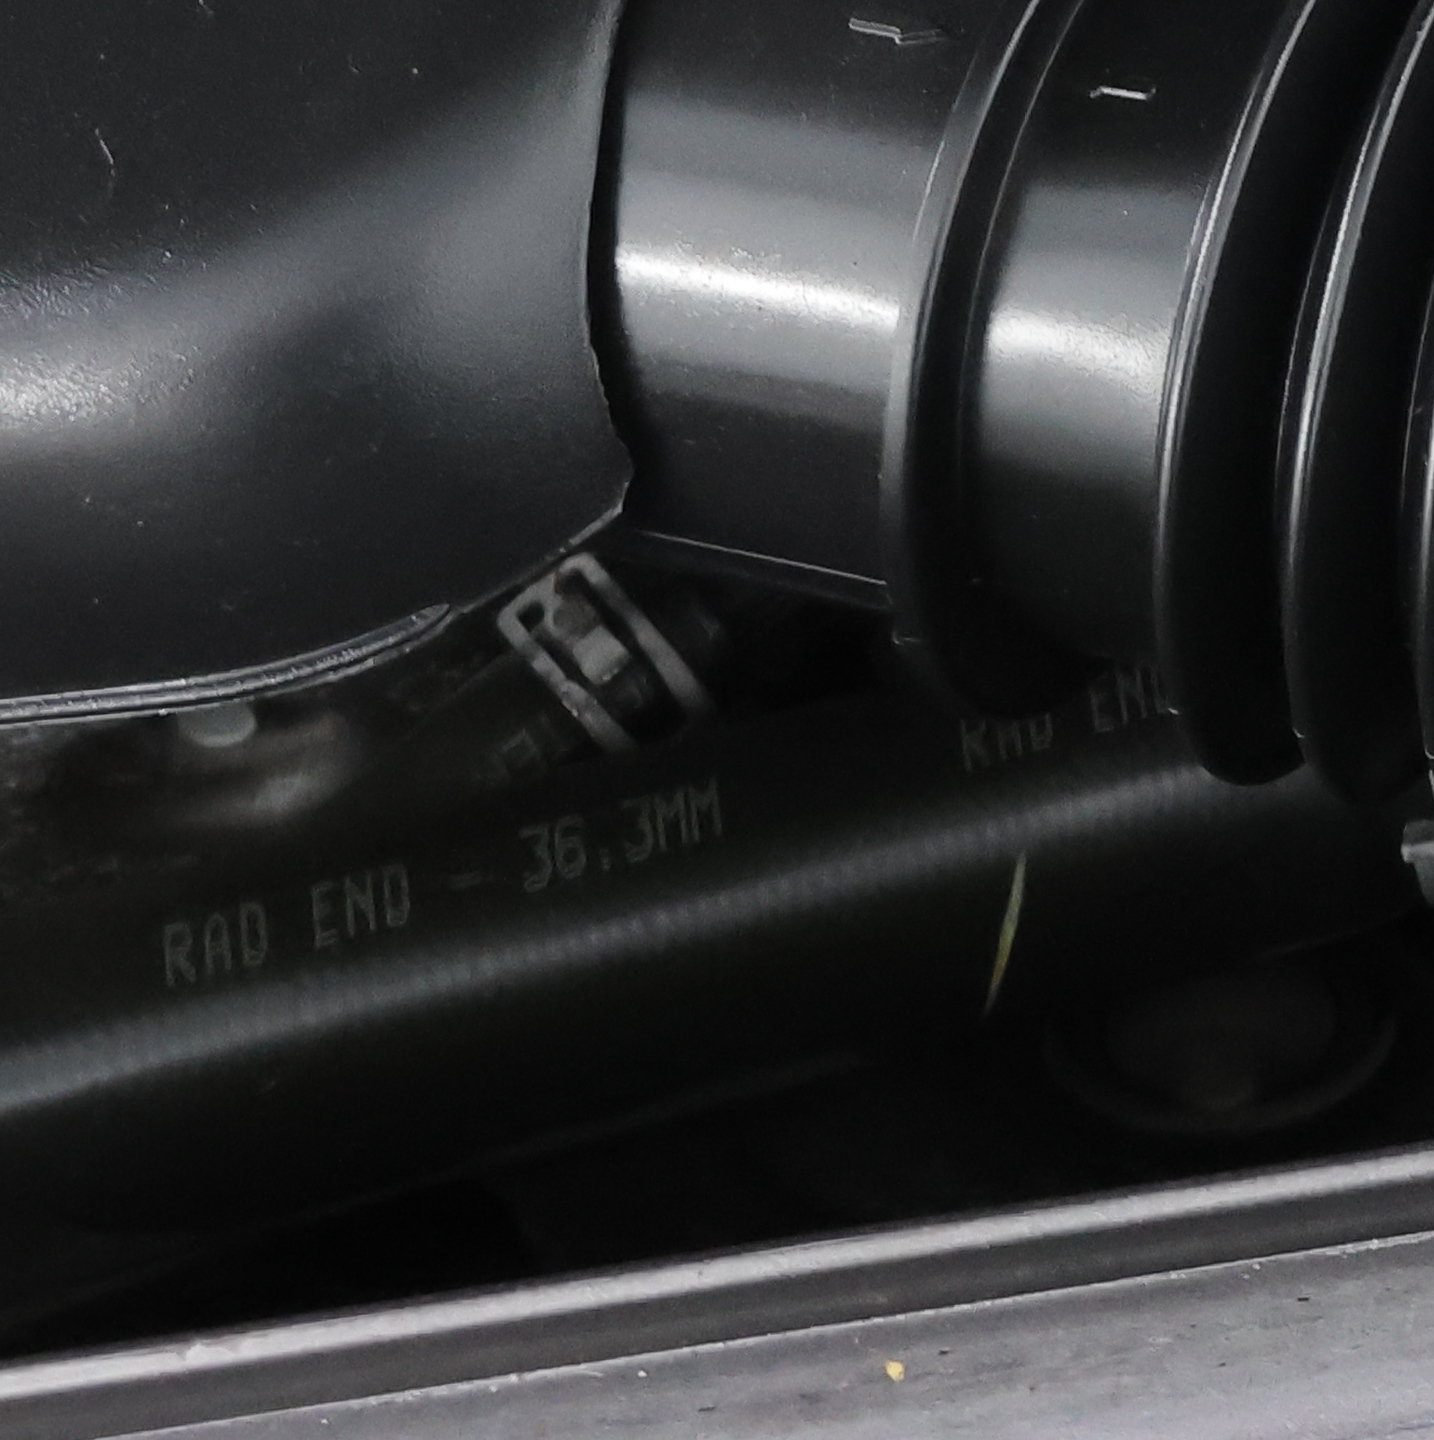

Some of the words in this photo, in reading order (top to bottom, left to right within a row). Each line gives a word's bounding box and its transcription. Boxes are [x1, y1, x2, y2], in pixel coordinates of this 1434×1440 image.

[161, 901, 270, 989] RAD
[311, 862, 412, 951] END
[519, 776, 724, 895] 36.3MM
